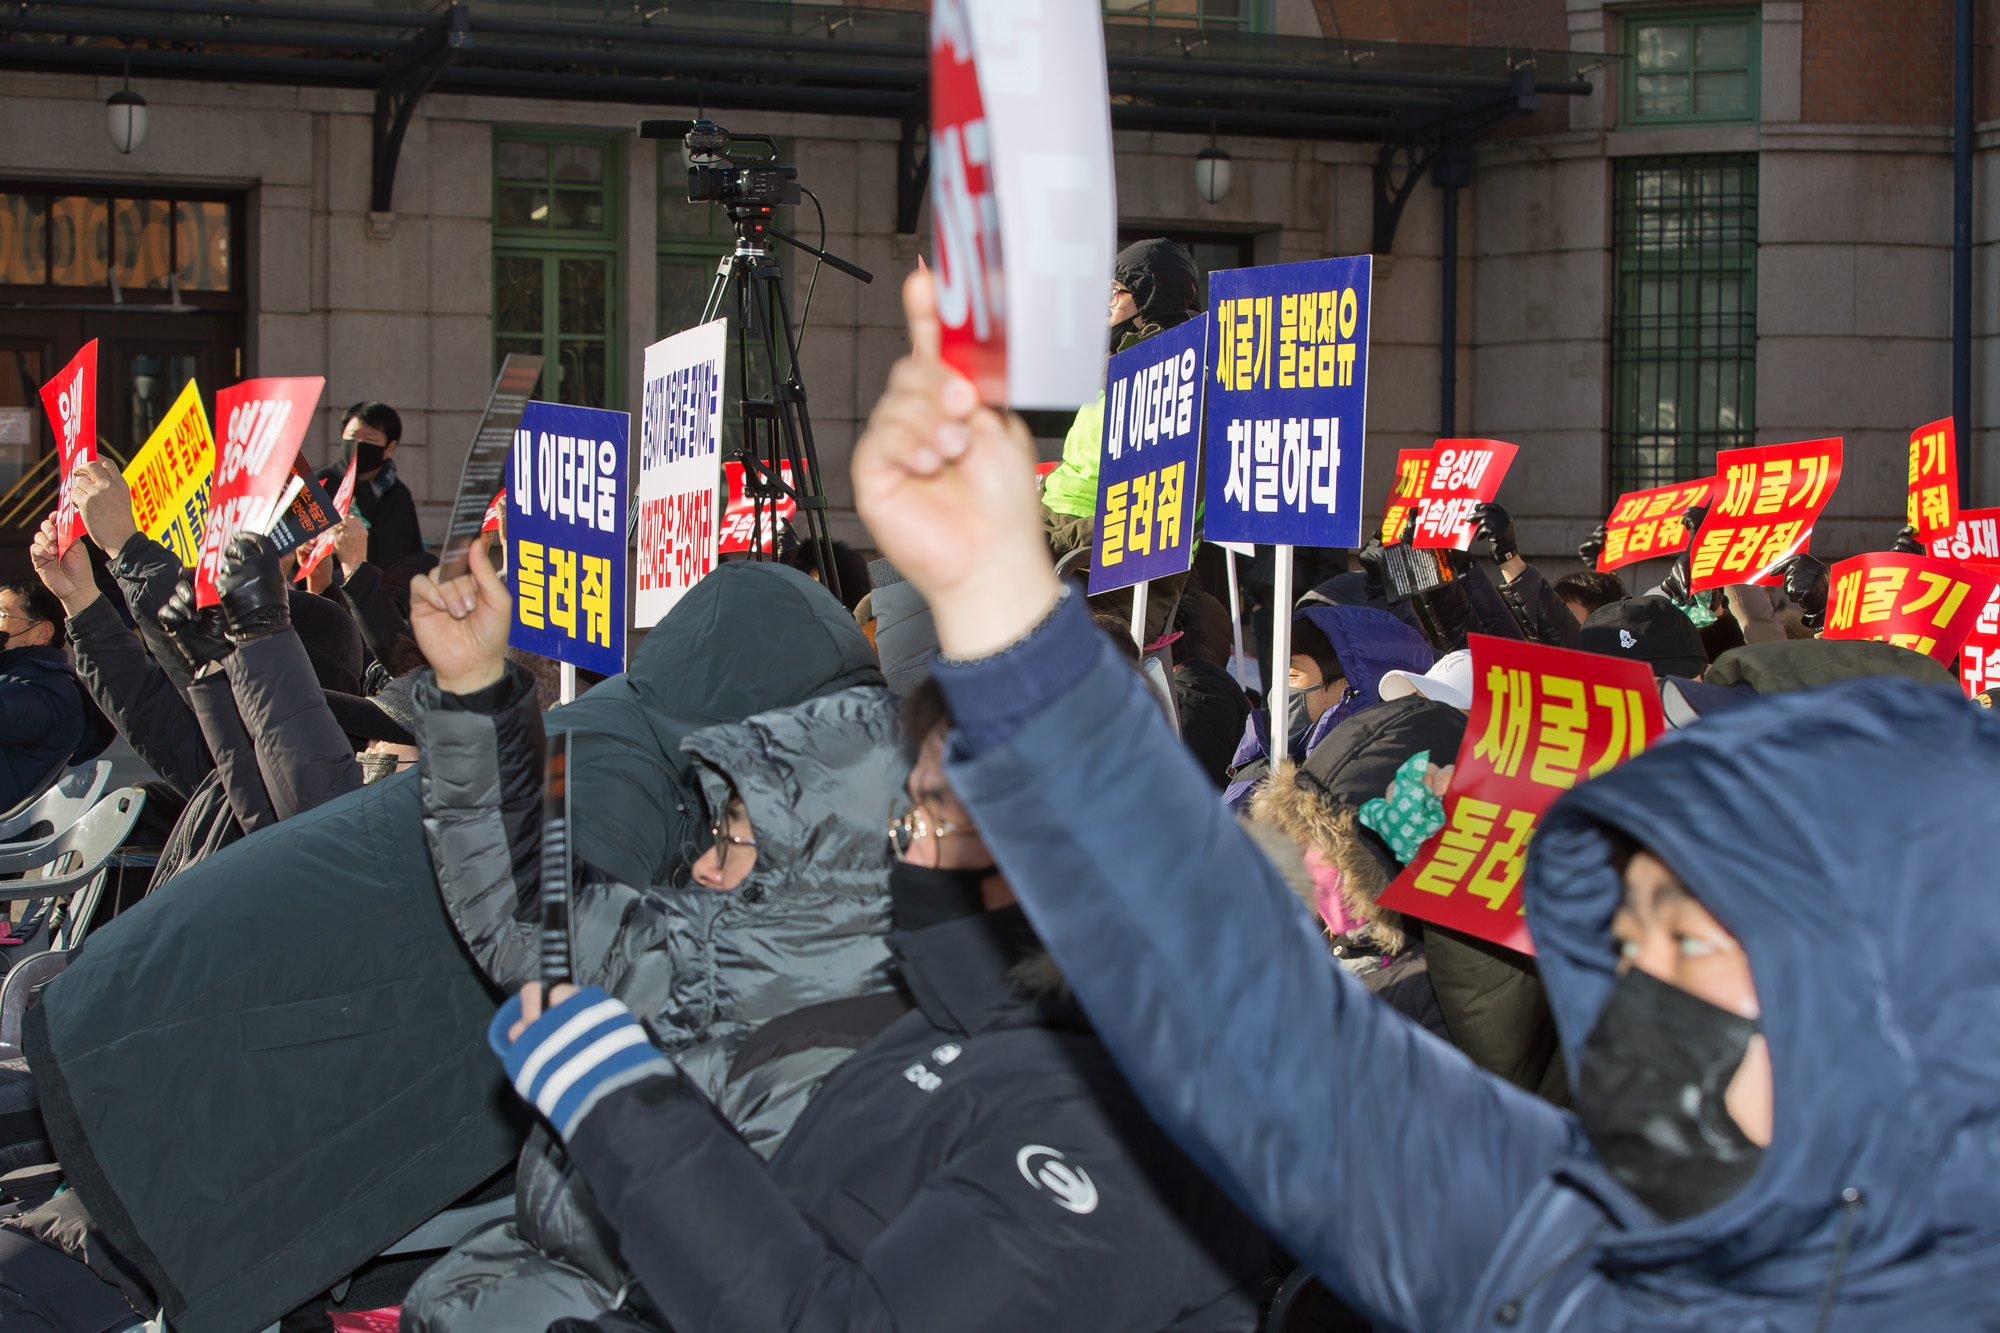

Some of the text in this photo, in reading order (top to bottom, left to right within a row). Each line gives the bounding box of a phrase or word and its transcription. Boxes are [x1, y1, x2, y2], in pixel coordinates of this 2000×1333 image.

[1216, 287, 1358, 391] 채굴기 불법점유
[1108, 347, 1196, 460] 내 이더리움
[130, 402, 209, 533] 힘들어서 못 살겠다
[514, 429, 532, 516] 내
[538, 431, 617, 533] 이더리움
[1102, 461, 1186, 567] 돌려줘
[1223, 417, 1341, 514] 처벌하라
[1431, 449, 1494, 490] 윤성재
[1612, 484, 1709, 523] 채굴기
[1717, 455, 1829, 517] 채굴기
[676, 488, 712, 588] 각성하라
[1414, 498, 1481, 538] 구속하라
[1604, 515, 1685, 564] 돌려줘
[1691, 519, 1804, 579] 돌려줘
[518, 539, 611, 648] 돌려줘
[1829, 567, 1971, 630] 채굴기
[1473, 665, 1646, 789] 채굴기
